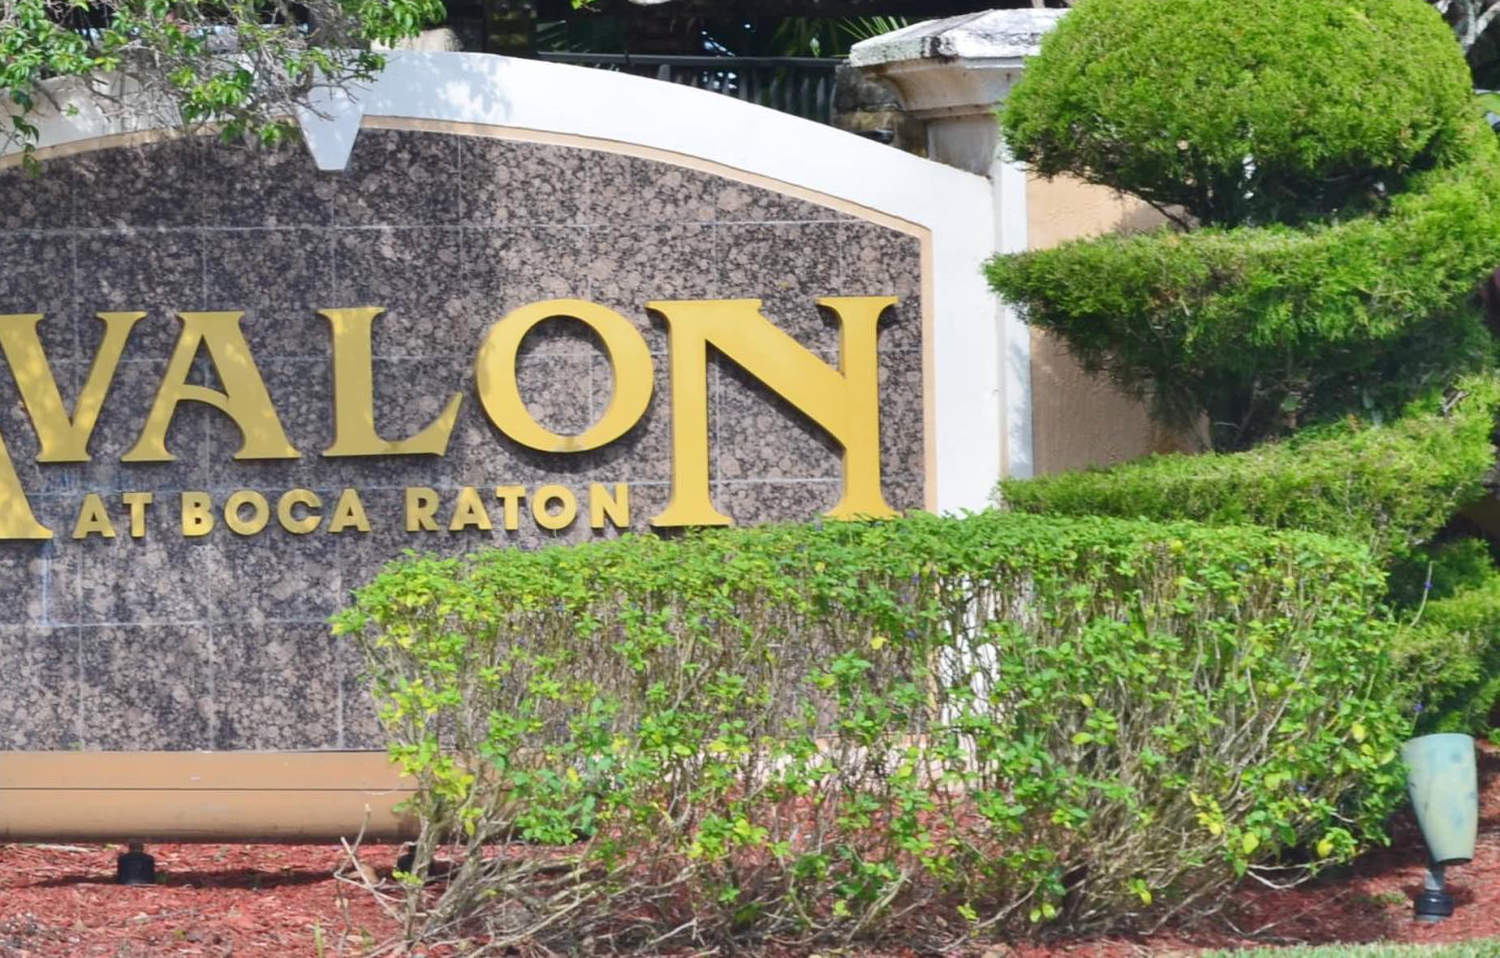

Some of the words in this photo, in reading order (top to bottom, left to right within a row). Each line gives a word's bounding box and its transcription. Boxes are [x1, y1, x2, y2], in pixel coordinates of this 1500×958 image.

[74, 491, 153, 539] AT
[180, 488, 371, 537] BOCA
[404, 482, 631, 532] RATON
